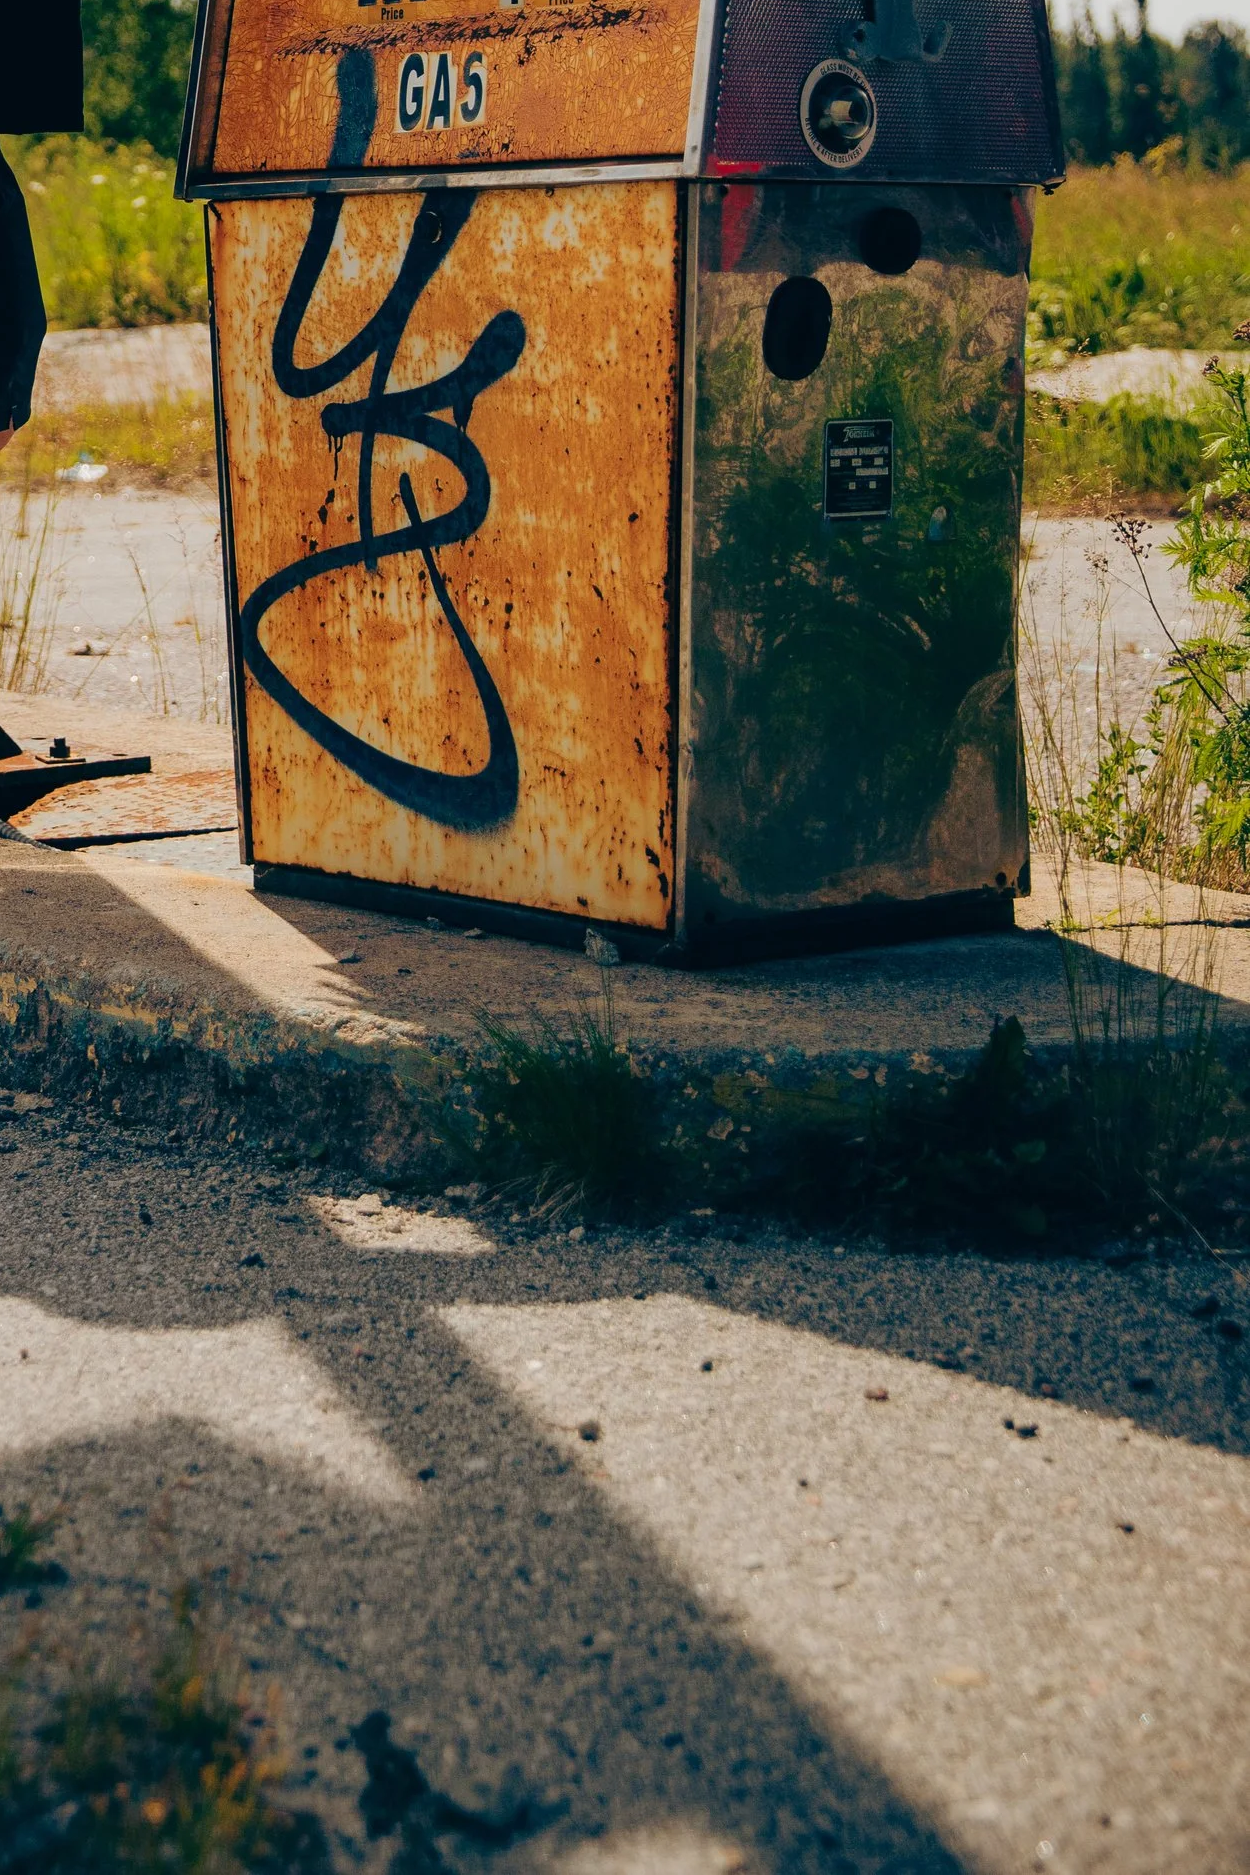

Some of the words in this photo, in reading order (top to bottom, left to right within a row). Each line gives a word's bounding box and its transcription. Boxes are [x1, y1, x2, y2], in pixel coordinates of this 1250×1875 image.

[380, 7, 404, 21] Price
[820, 63, 838, 77] GLASS
[398, 50, 484, 132] GAS
[821, 148, 838, 162] AFTER
[838, 145, 864, 164] DELIVERY
